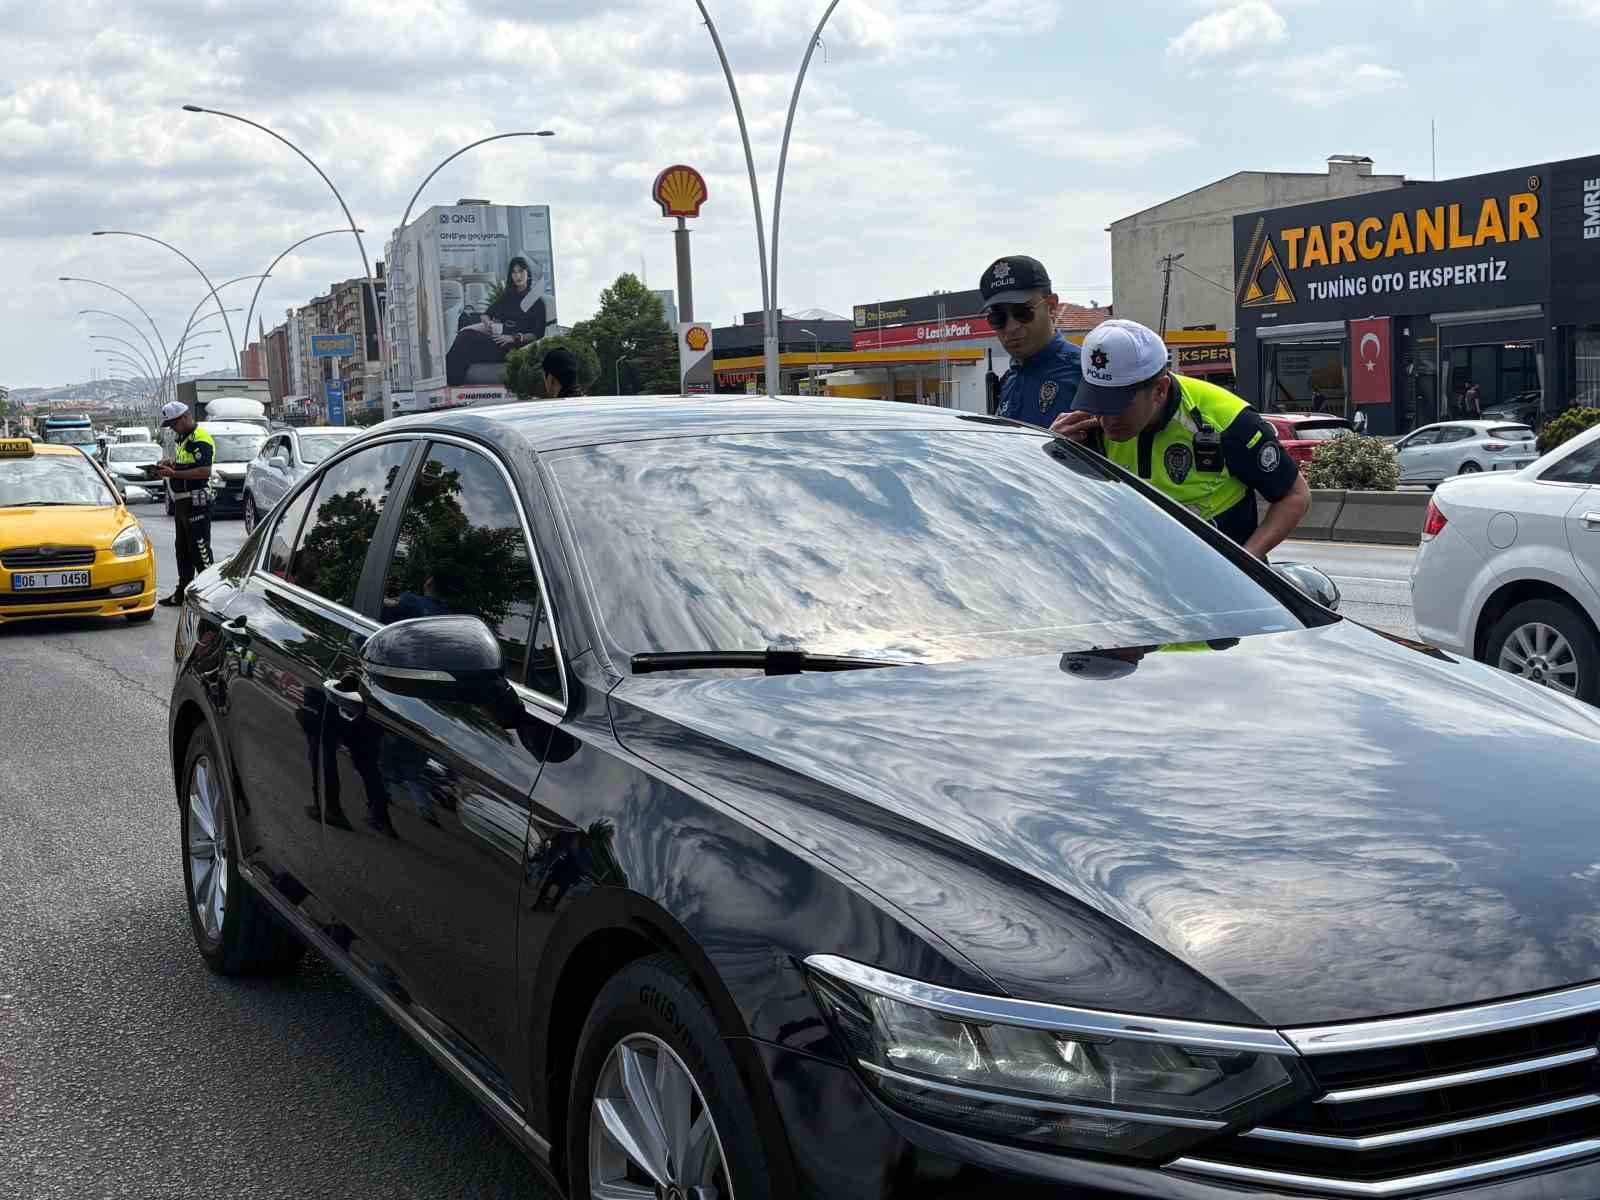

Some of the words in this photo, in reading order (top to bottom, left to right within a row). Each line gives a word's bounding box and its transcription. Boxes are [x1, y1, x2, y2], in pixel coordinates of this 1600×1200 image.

[451, 214, 475, 224] QNB
[1583, 178, 1600, 239] EMRE
[1281, 192, 1541, 270] TARCANLAR
[1308, 275, 1367, 300] TUNİNG
[1371, 272, 1404, 293] OTO
[1409, 256, 1507, 289] EKSPERTİZ
[1177, 348, 1235, 361] EKSPER
[22, 575, 35, 587] 06
[43, 574, 49, 586] T
[61, 573, 88, 585] 0458
